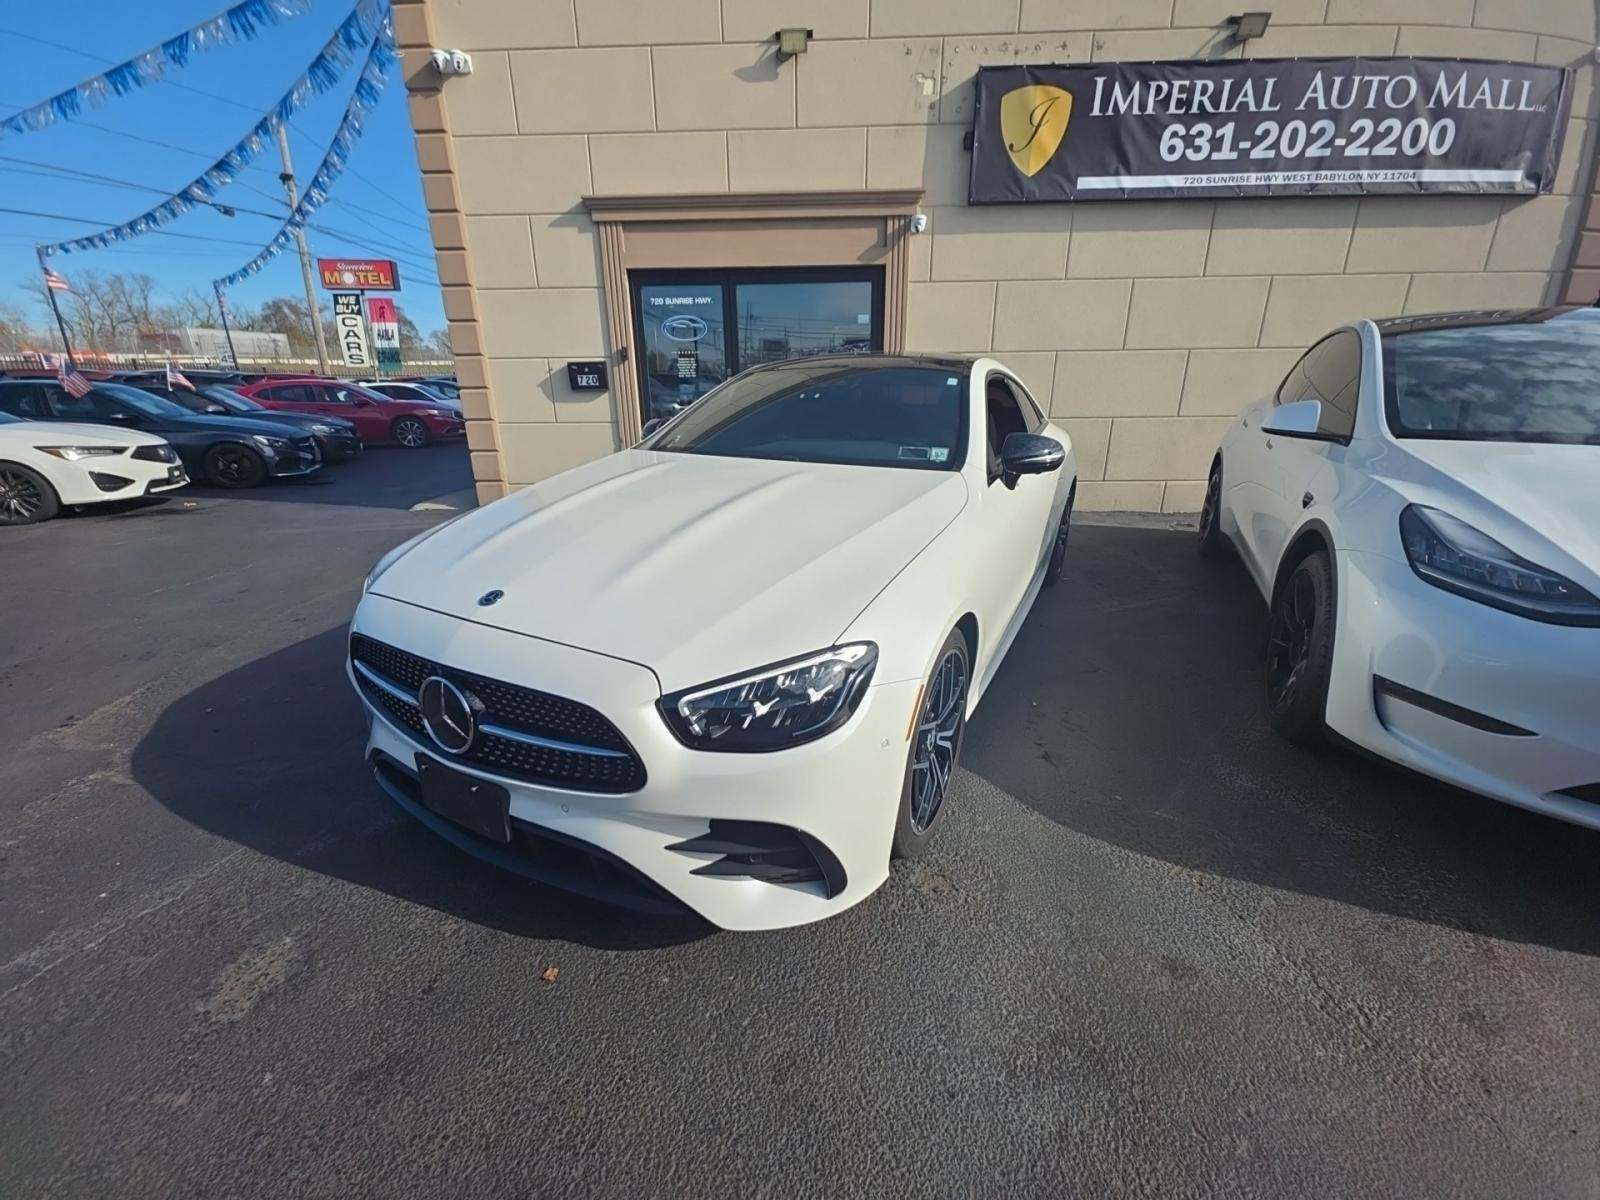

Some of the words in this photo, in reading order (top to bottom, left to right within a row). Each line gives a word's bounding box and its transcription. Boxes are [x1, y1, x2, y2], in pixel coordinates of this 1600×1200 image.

[1089, 76, 1283, 117] IMPERIAL
[1294, 69, 1418, 111] AUTO
[1427, 69, 1537, 112] MALL
[1158, 117, 1456, 163] 631-202-2200
[1184, 176, 1203, 185] 720
[1206, 175, 1252, 185] SUNRISE
[1255, 174, 1280, 183] HWY
[1282, 173, 1312, 182] WEST
[1382, 171, 1417, 181] 11704
[324, 270, 391, 285] MOTEL
[337, 295, 357, 305] WE
[650, 297, 664, 305] 720
[664, 297, 694, 305] SUNRISE
[335, 304, 360, 314] BUY
[341, 316, 366, 365] CARS
[578, 375, 598, 385] 720
